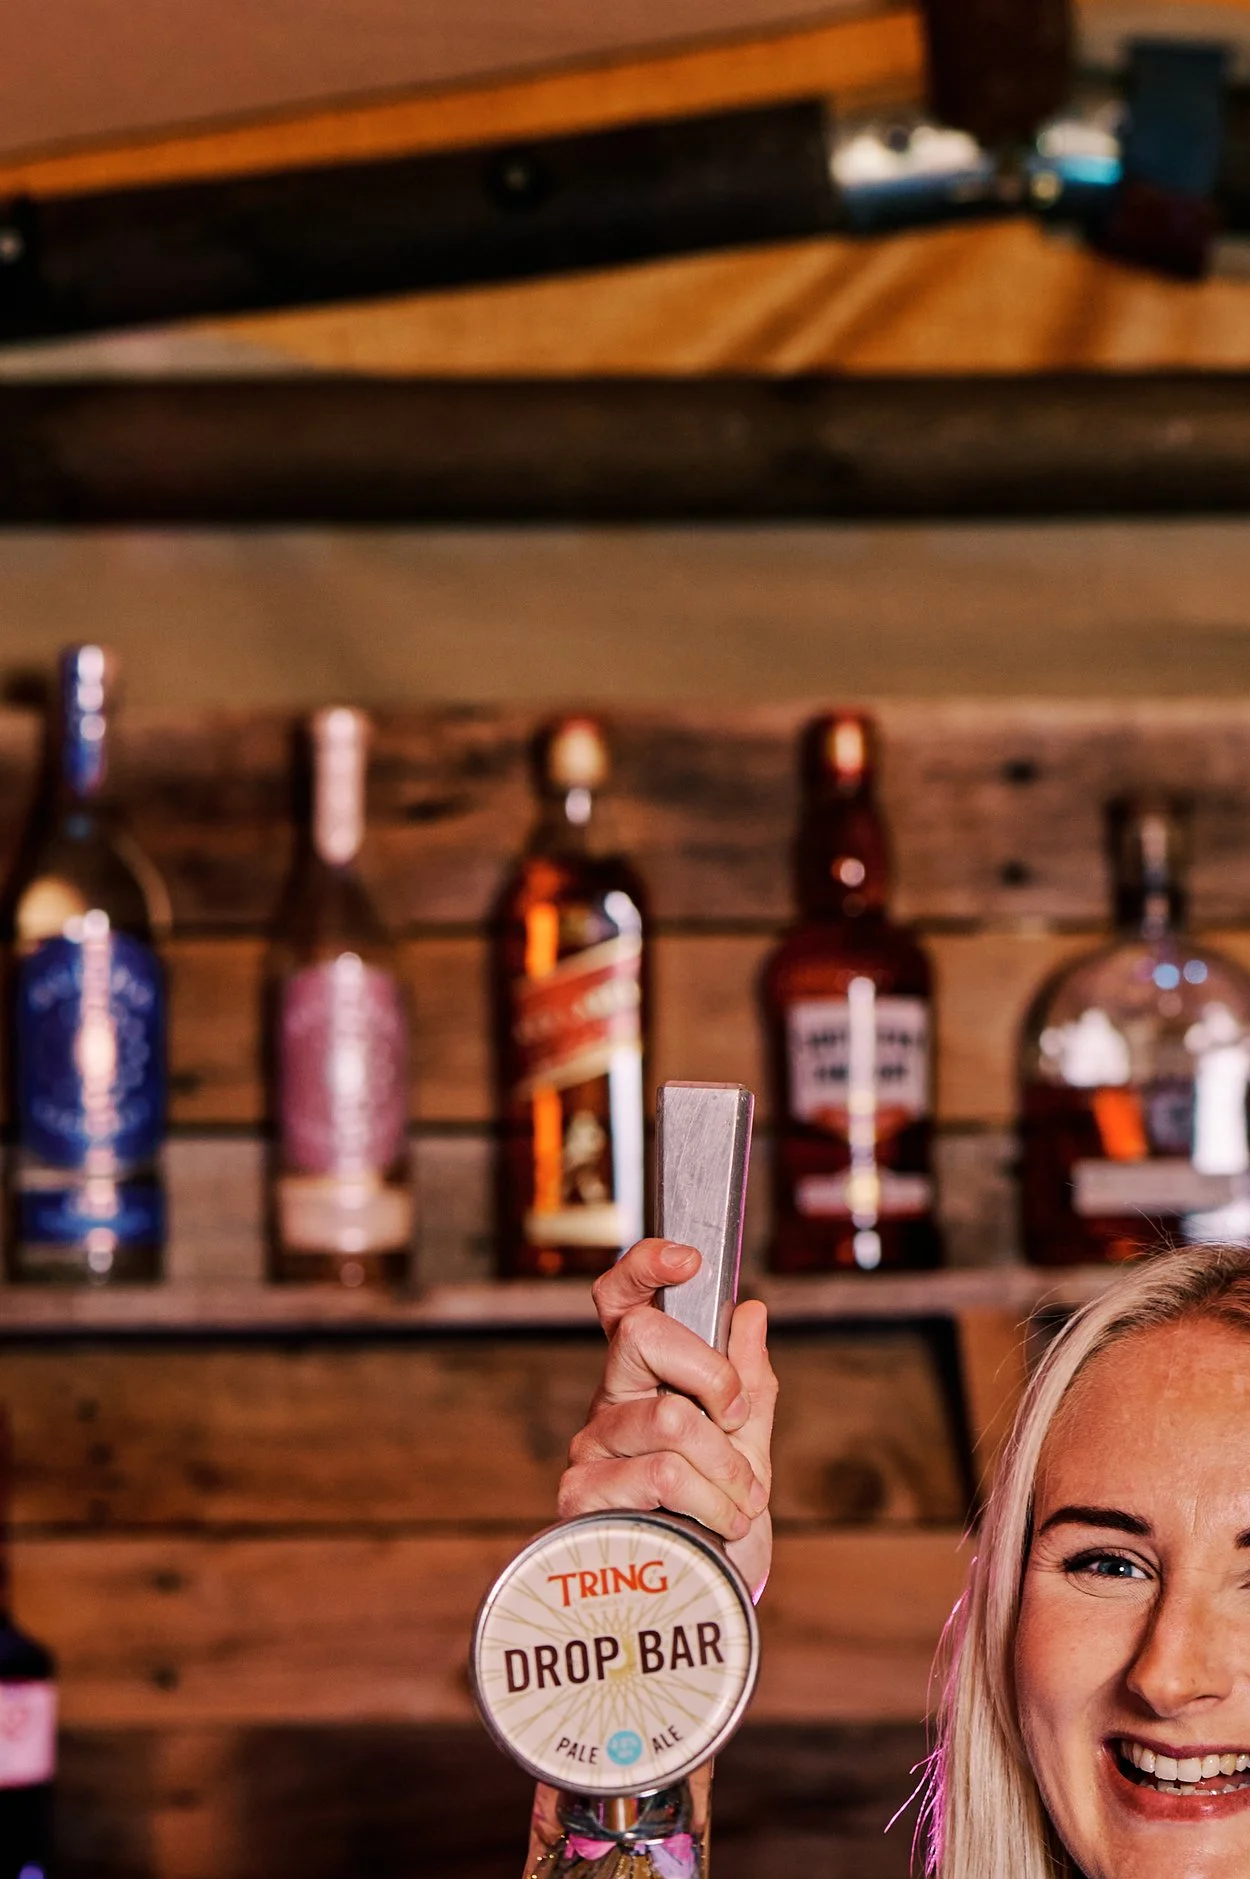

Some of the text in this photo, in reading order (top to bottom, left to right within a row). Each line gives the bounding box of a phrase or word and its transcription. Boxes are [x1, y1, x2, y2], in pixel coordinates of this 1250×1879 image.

[547, 1560, 669, 1608] TRING
[504, 1621, 725, 1693] DROP BAR
[555, 1736, 600, 1765] PALE
[652, 1725, 684, 1754] ALE
